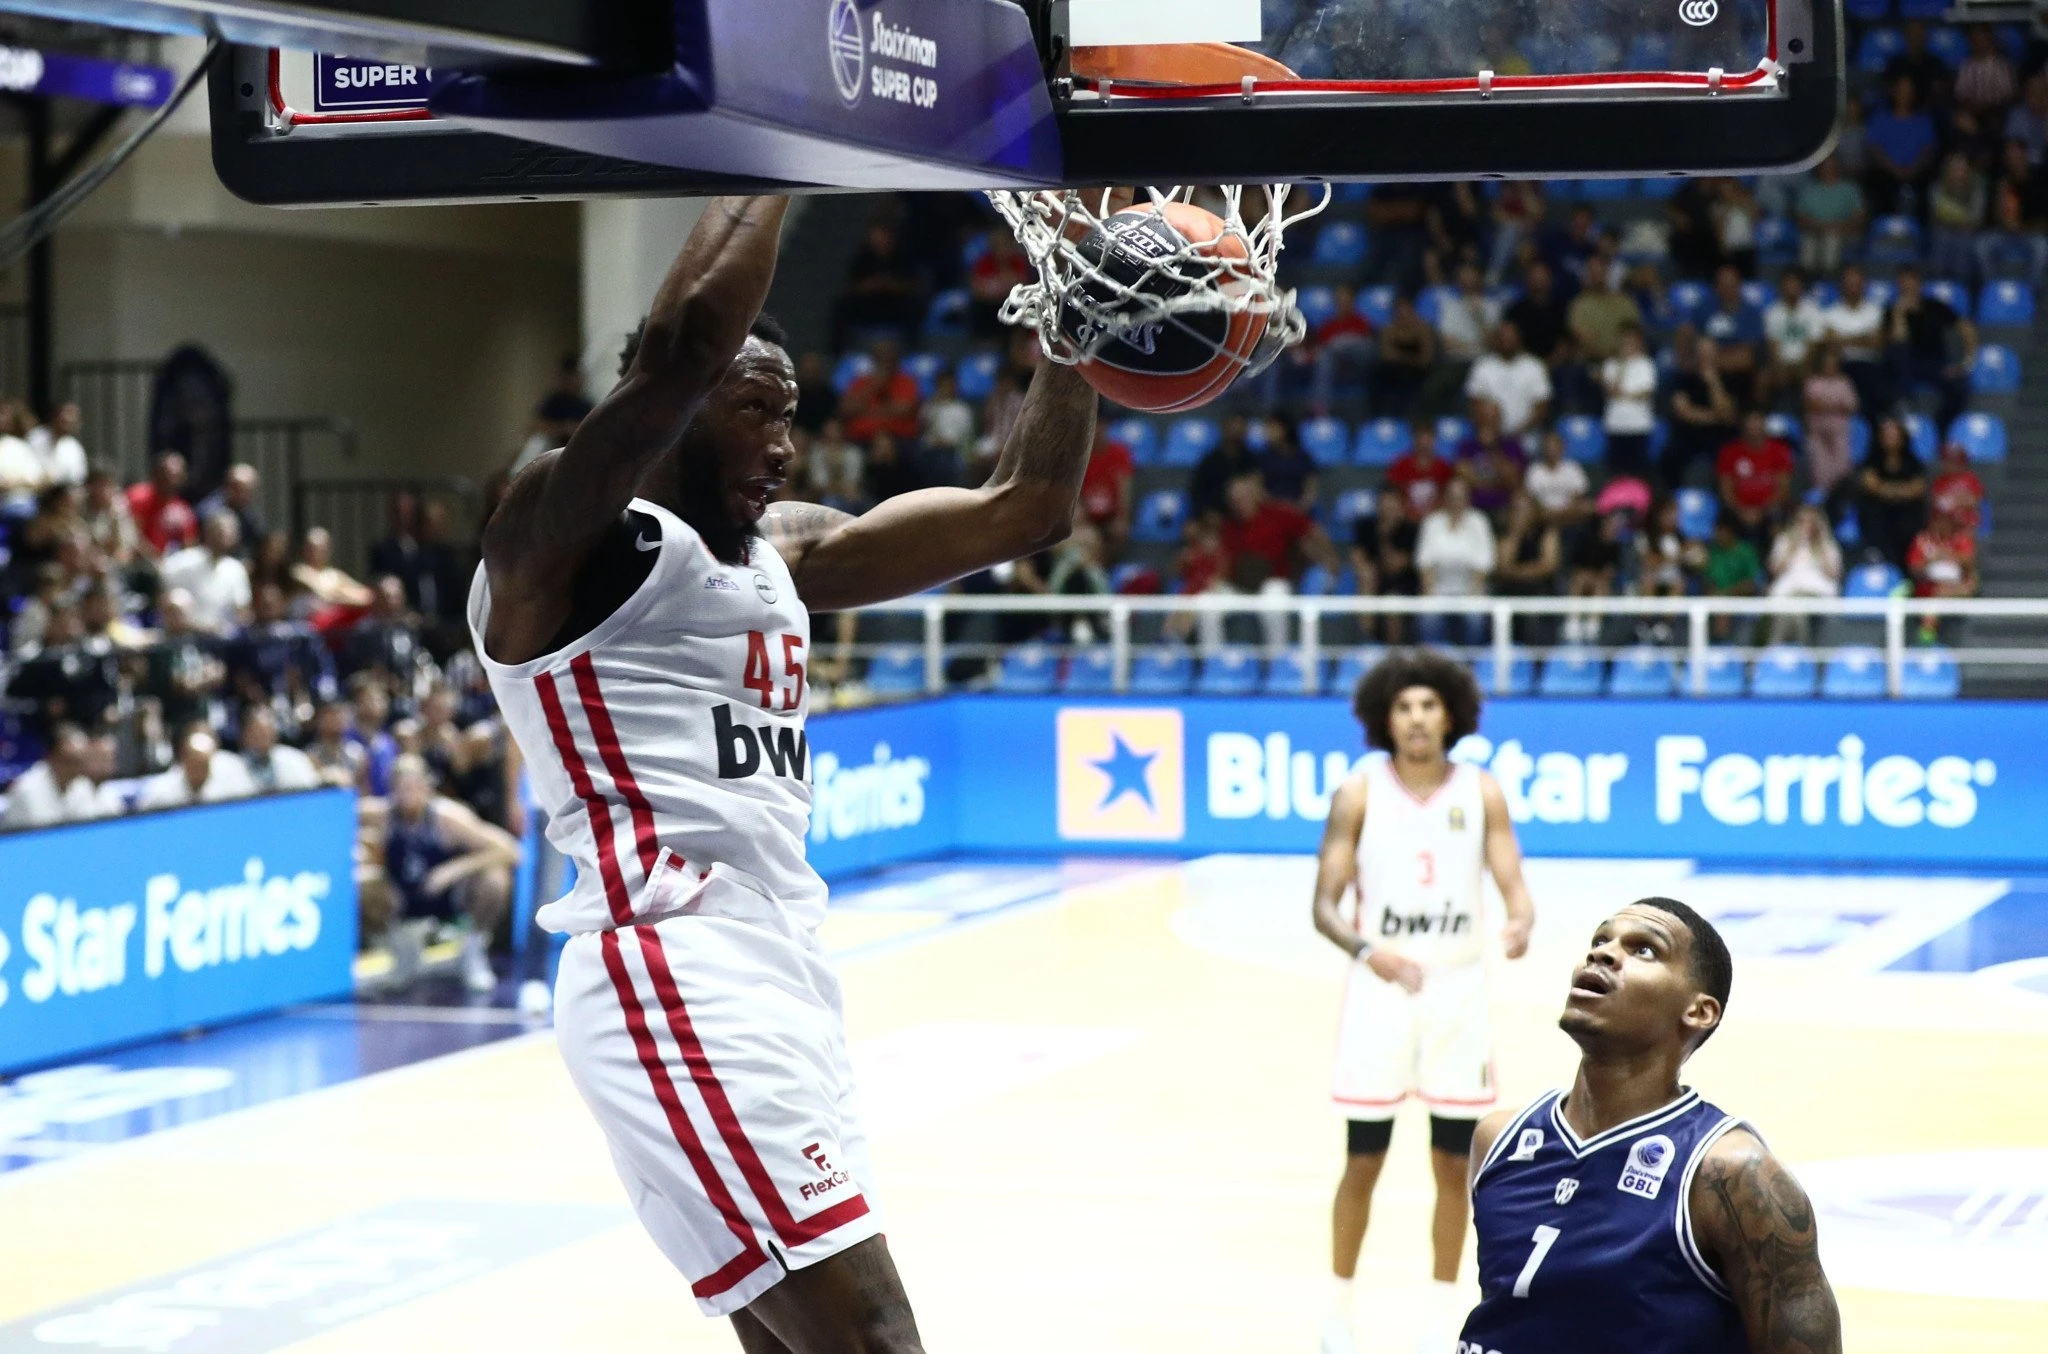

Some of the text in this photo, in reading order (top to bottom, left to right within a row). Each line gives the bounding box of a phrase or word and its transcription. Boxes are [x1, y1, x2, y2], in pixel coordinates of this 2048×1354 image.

[334, 64, 418, 89] SUPER
[870, 11, 937, 68] Stoiximan
[871, 65, 938, 109] SUPER CUP
[743, 630, 804, 710] 45
[711, 703, 814, 784] bw
[1655, 733, 1980, 829] Ferries
[21, 892, 137, 1003] Star
[144, 856, 328, 978] Ferries
[1623, 1175, 1654, 1195] GBL
[1512, 1224, 1561, 1298] 1
